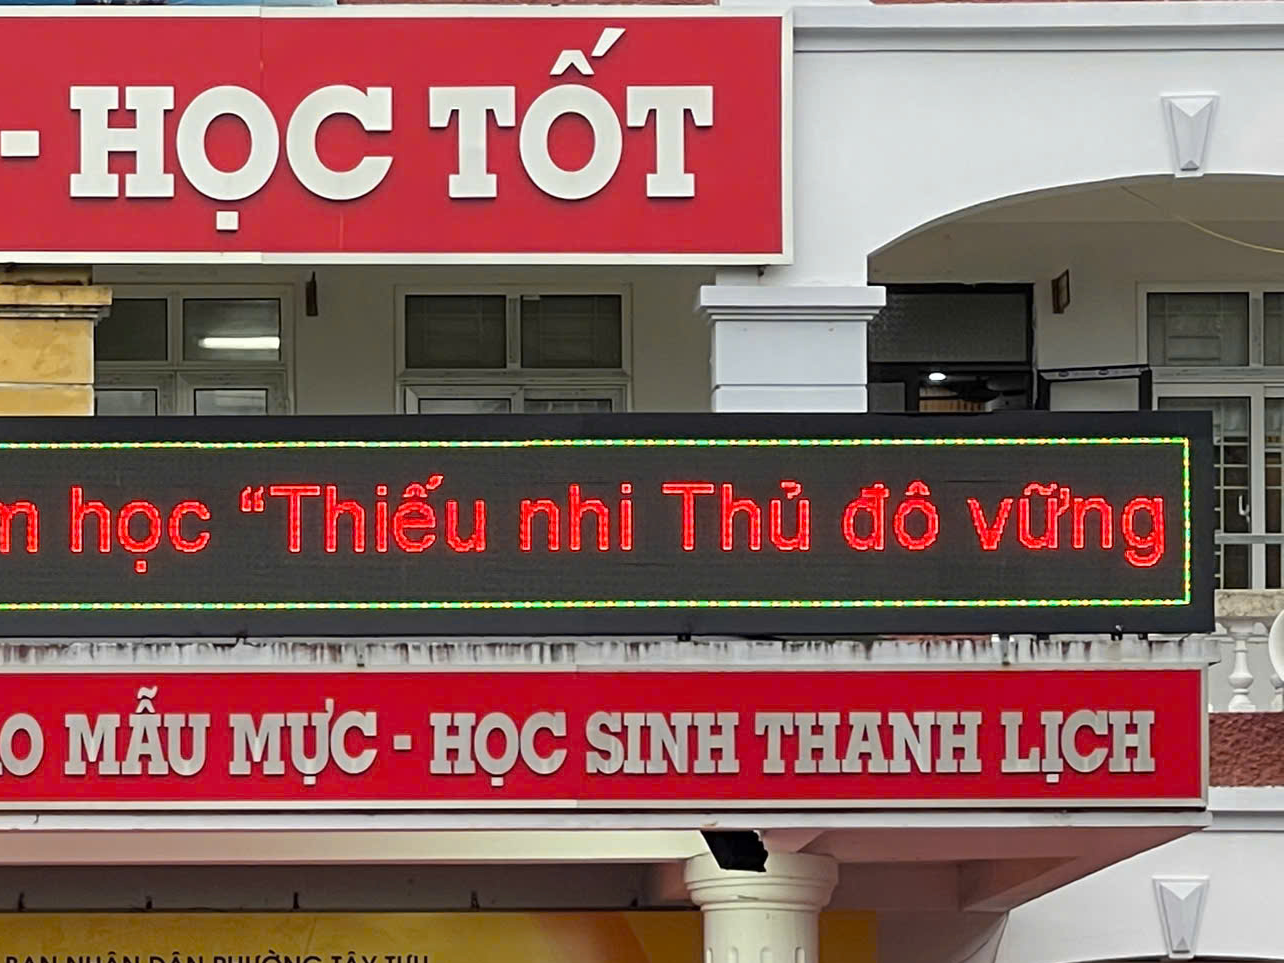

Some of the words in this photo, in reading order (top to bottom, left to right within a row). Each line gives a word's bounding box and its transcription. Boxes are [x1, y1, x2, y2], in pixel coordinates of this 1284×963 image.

[0, 130, 40, 157] -
[70, 84, 394, 231] HỌC
[429, 27, 714, 200] TỐT
[70, 486, 211, 573] học
[519, 483, 632, 553] nhi
[661, 481, 810, 551] Thủ
[842, 481, 939, 551] đô
[967, 483, 1165, 567] vững
[64, 686, 211, 777] MẪU
[228, 698, 378, 786] MỰC
[393, 734, 412, 750] -
[429, 711, 568, 787] HỌC
[585, 711, 740, 775] SINH
[754, 711, 983, 774] THANH
[1000, 709, 1156, 784] LỊCH
